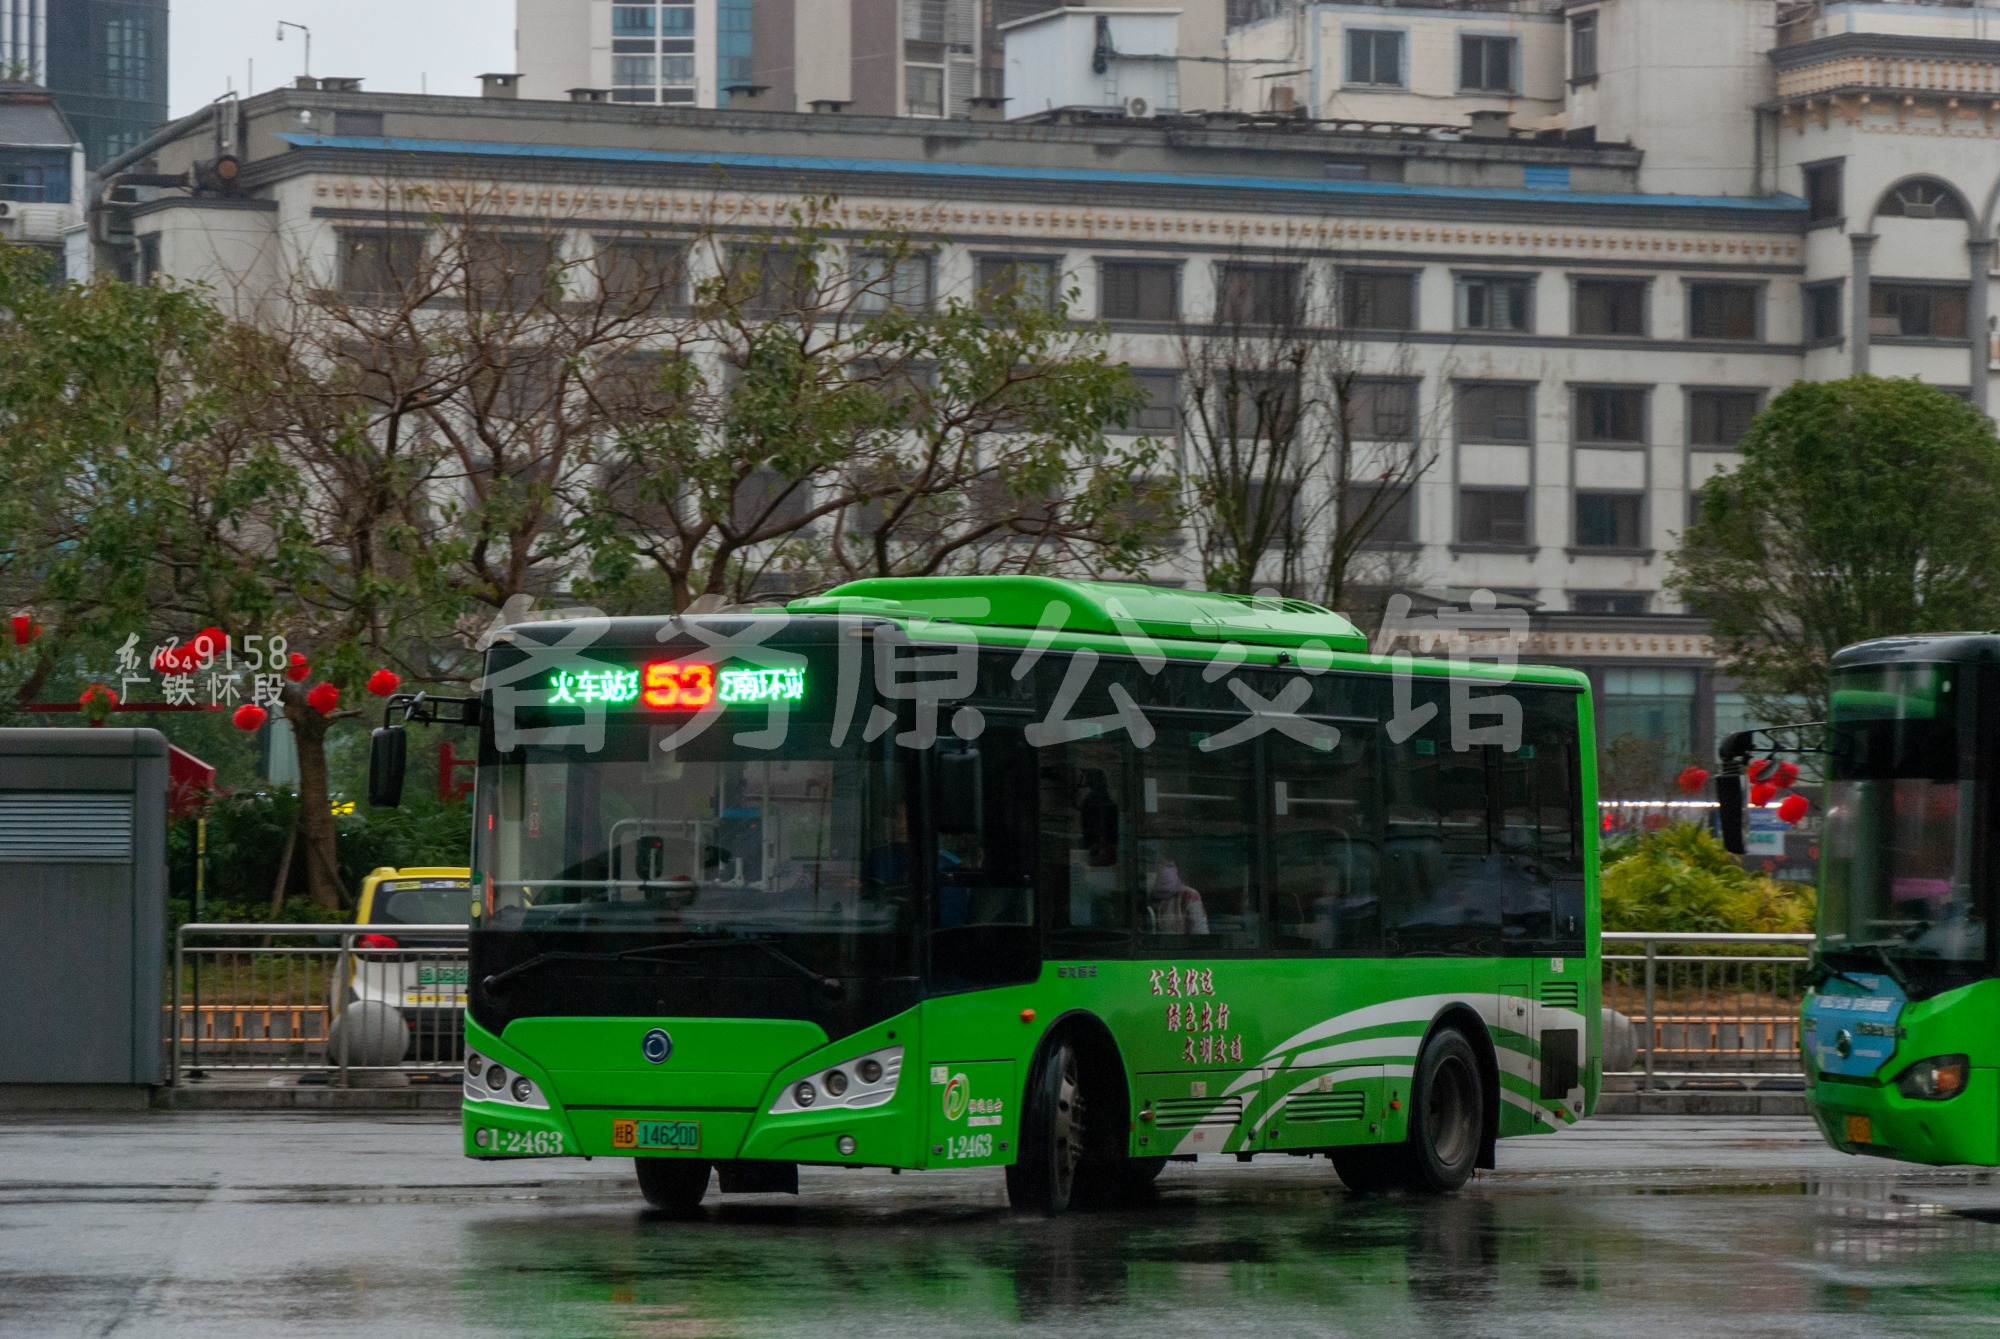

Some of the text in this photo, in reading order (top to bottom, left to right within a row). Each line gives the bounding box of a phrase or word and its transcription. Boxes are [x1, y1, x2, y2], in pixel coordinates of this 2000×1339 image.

[645, 664, 713, 708] 53
[1166, 1001, 1231, 1032] 绿色出行
[1182, 1034, 1244, 1064] 文明交通
[489, 1128, 564, 1155] 1-2463
[946, 1133, 993, 1160] 1-2463
